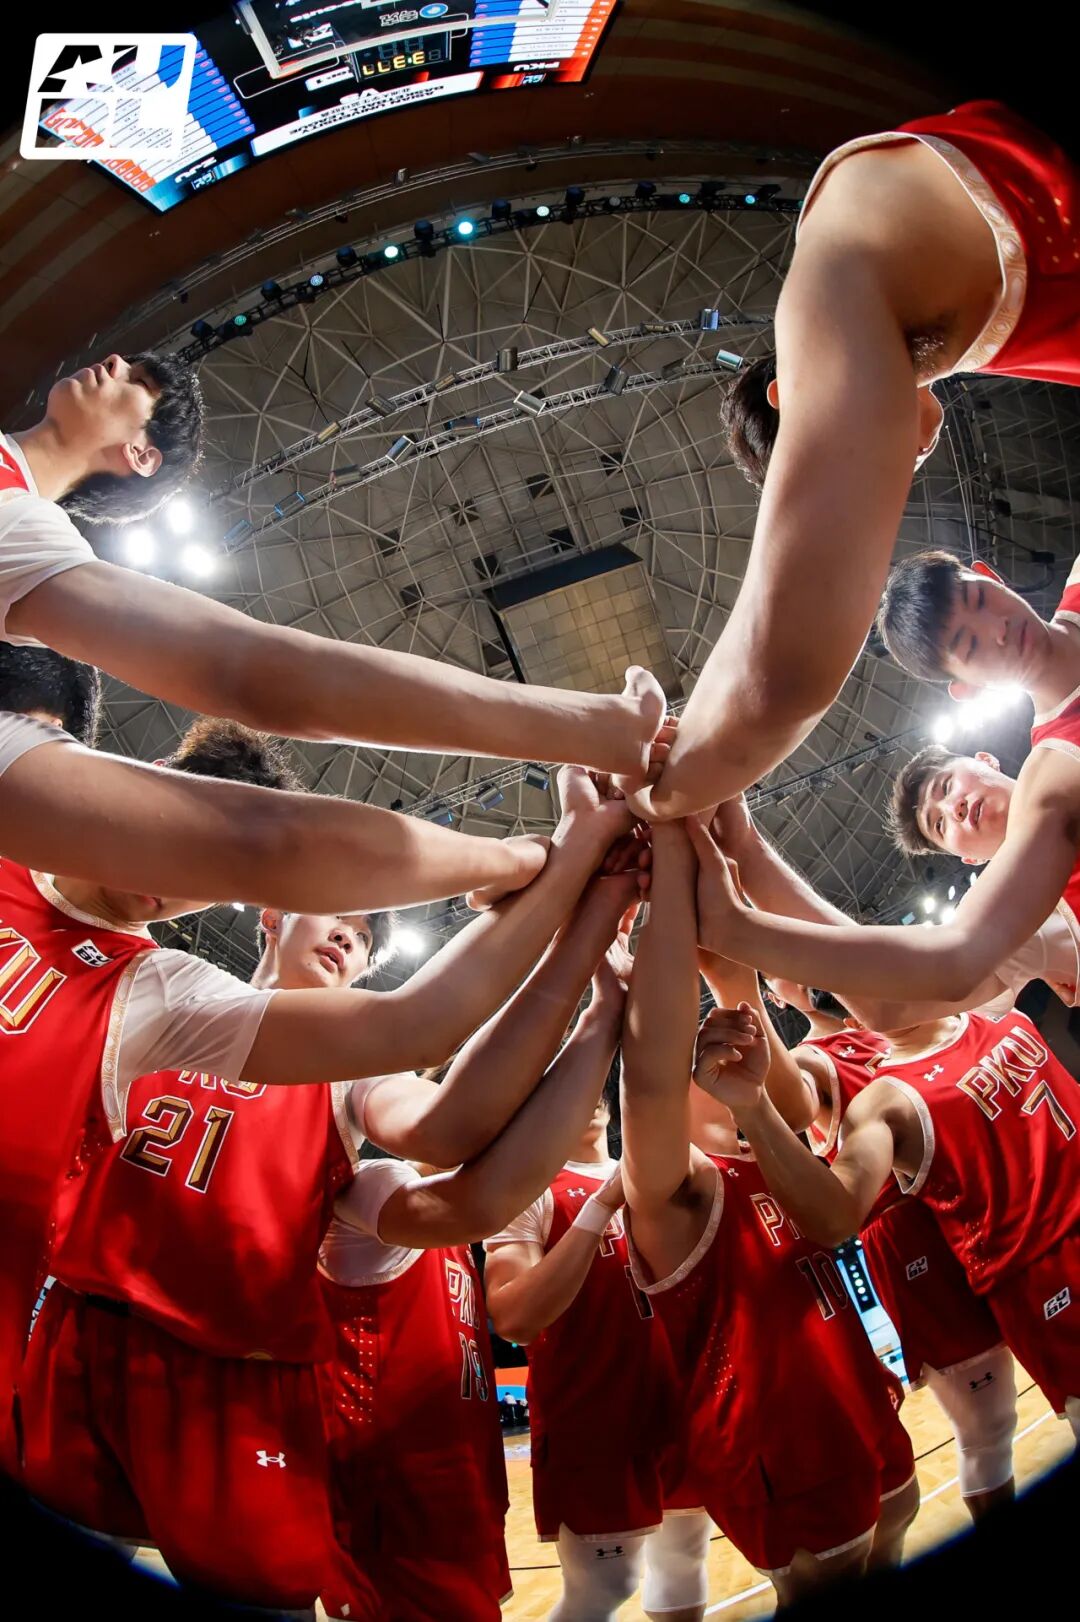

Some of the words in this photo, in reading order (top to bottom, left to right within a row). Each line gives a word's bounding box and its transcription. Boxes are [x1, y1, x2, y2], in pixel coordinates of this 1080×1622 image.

[513, 61, 560, 72] PKU
[0, 927, 68, 1035] U
[956, 1025, 1049, 1122] PKU
[1020, 1079, 1077, 1142] 7
[119, 1095, 236, 1194] 21
[795, 1250, 849, 1321] 10
